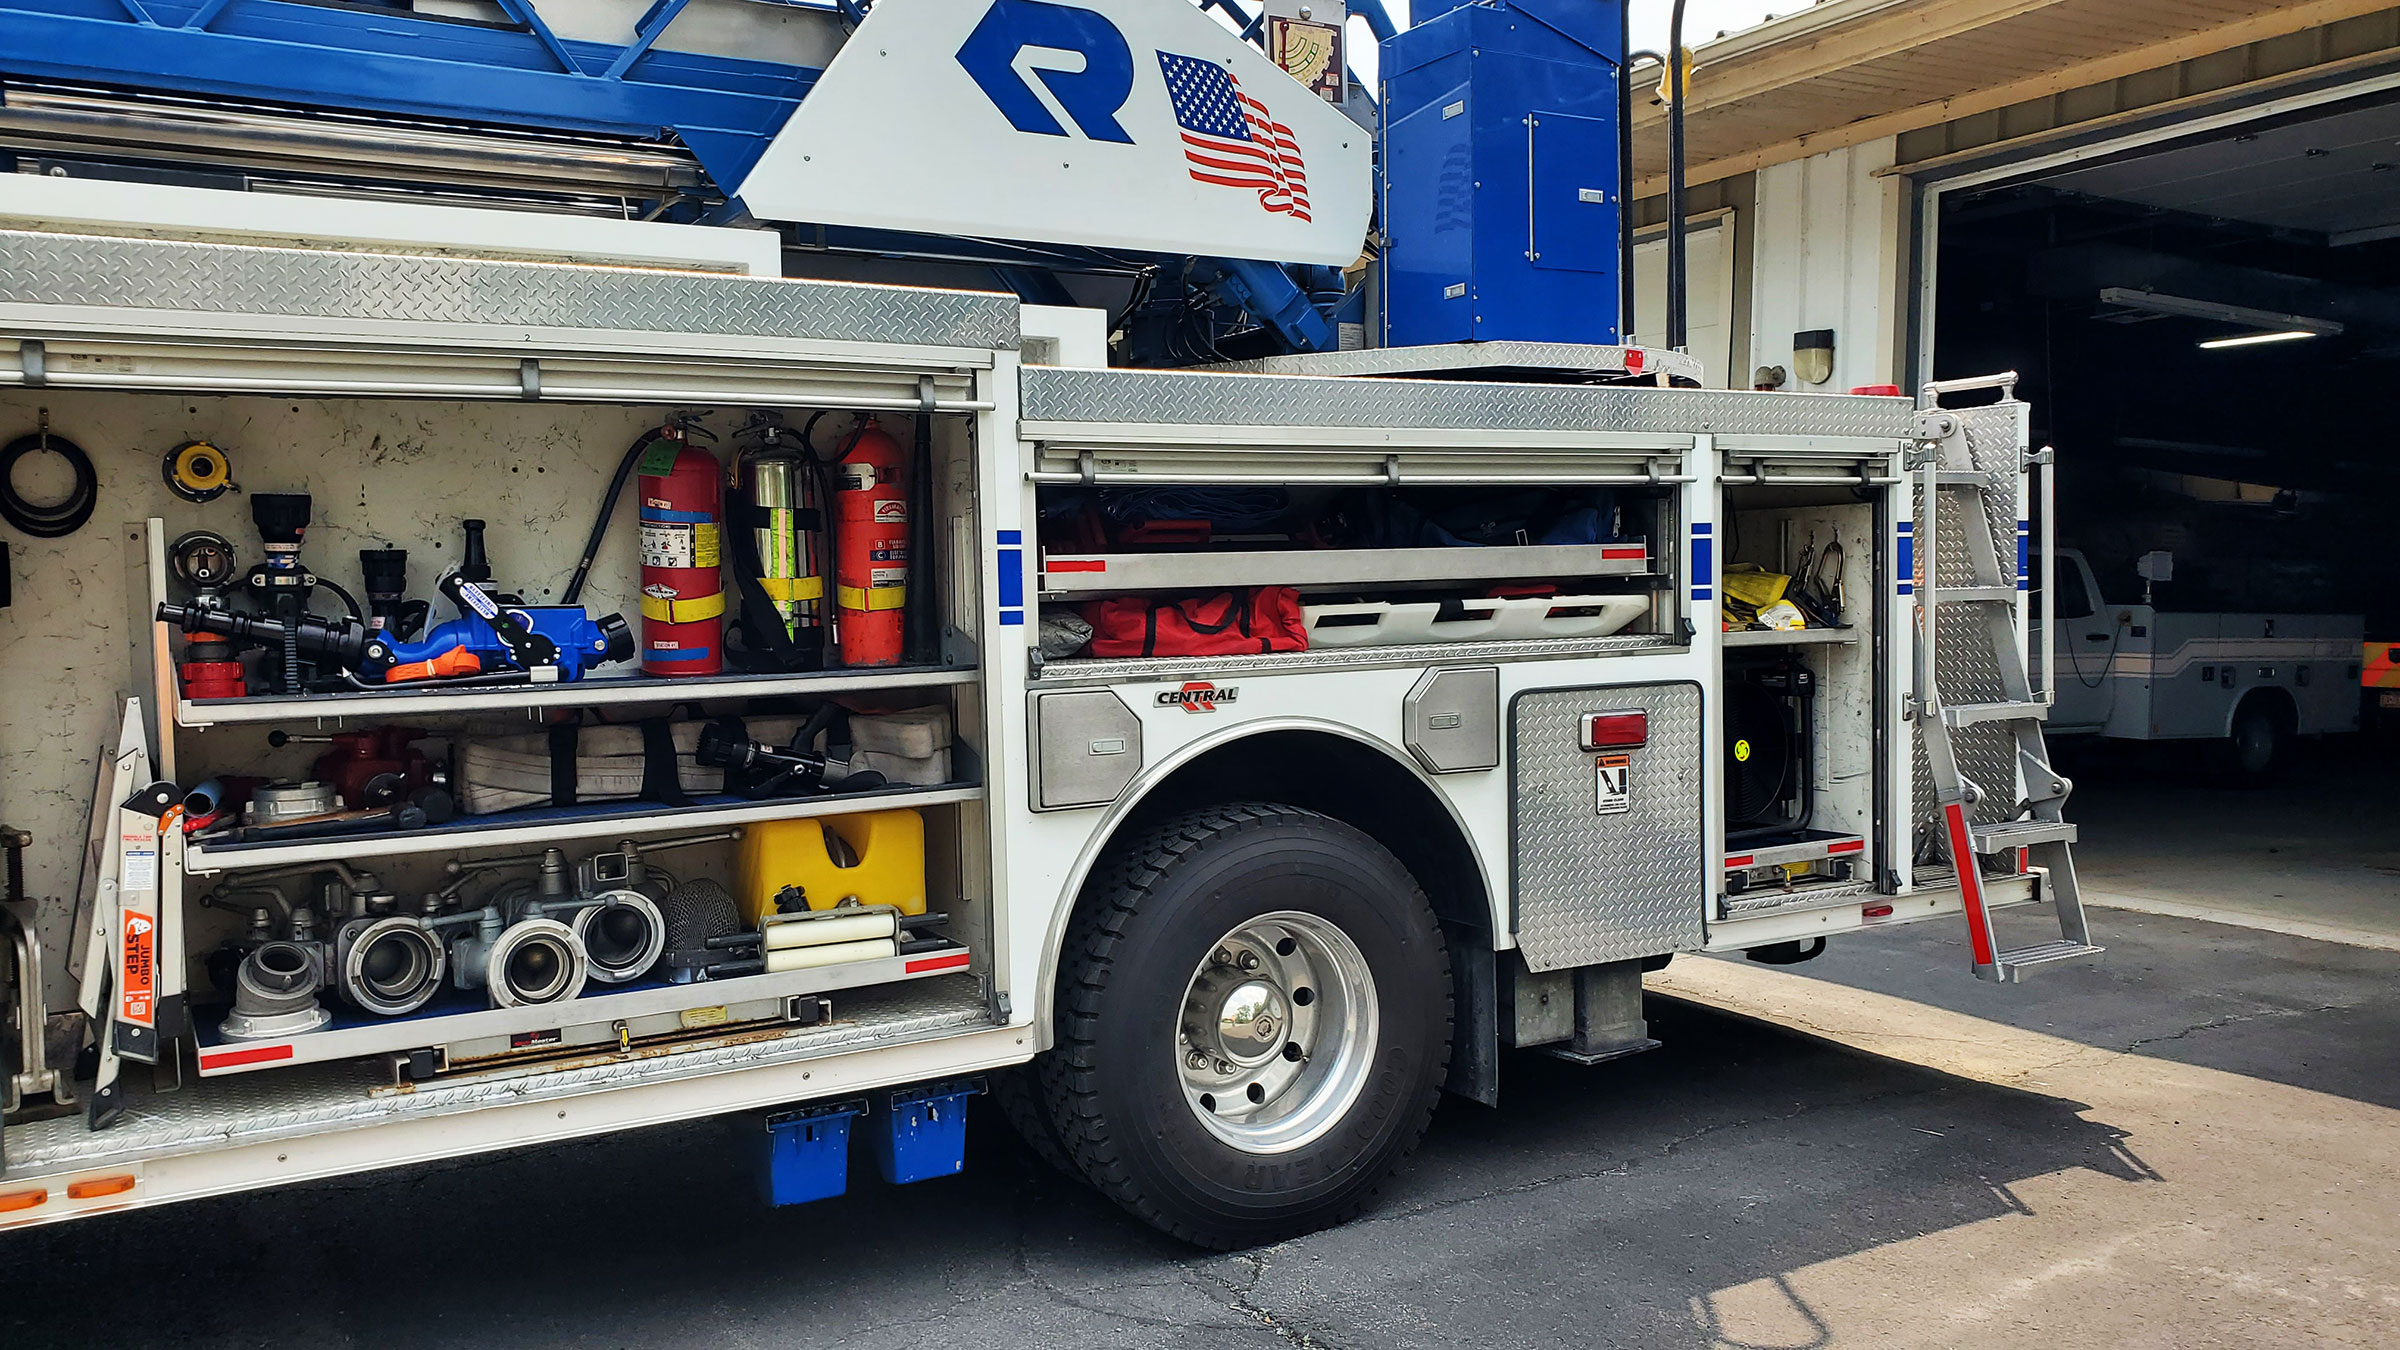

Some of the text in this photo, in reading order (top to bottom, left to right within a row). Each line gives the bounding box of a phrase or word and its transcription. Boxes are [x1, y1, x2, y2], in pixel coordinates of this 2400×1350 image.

[525, 333, 532, 342] 2
[1157, 688, 1237, 704] CENTRAL
[127, 934, 139, 975] STEP
[140, 945, 151, 985] JUMBO
